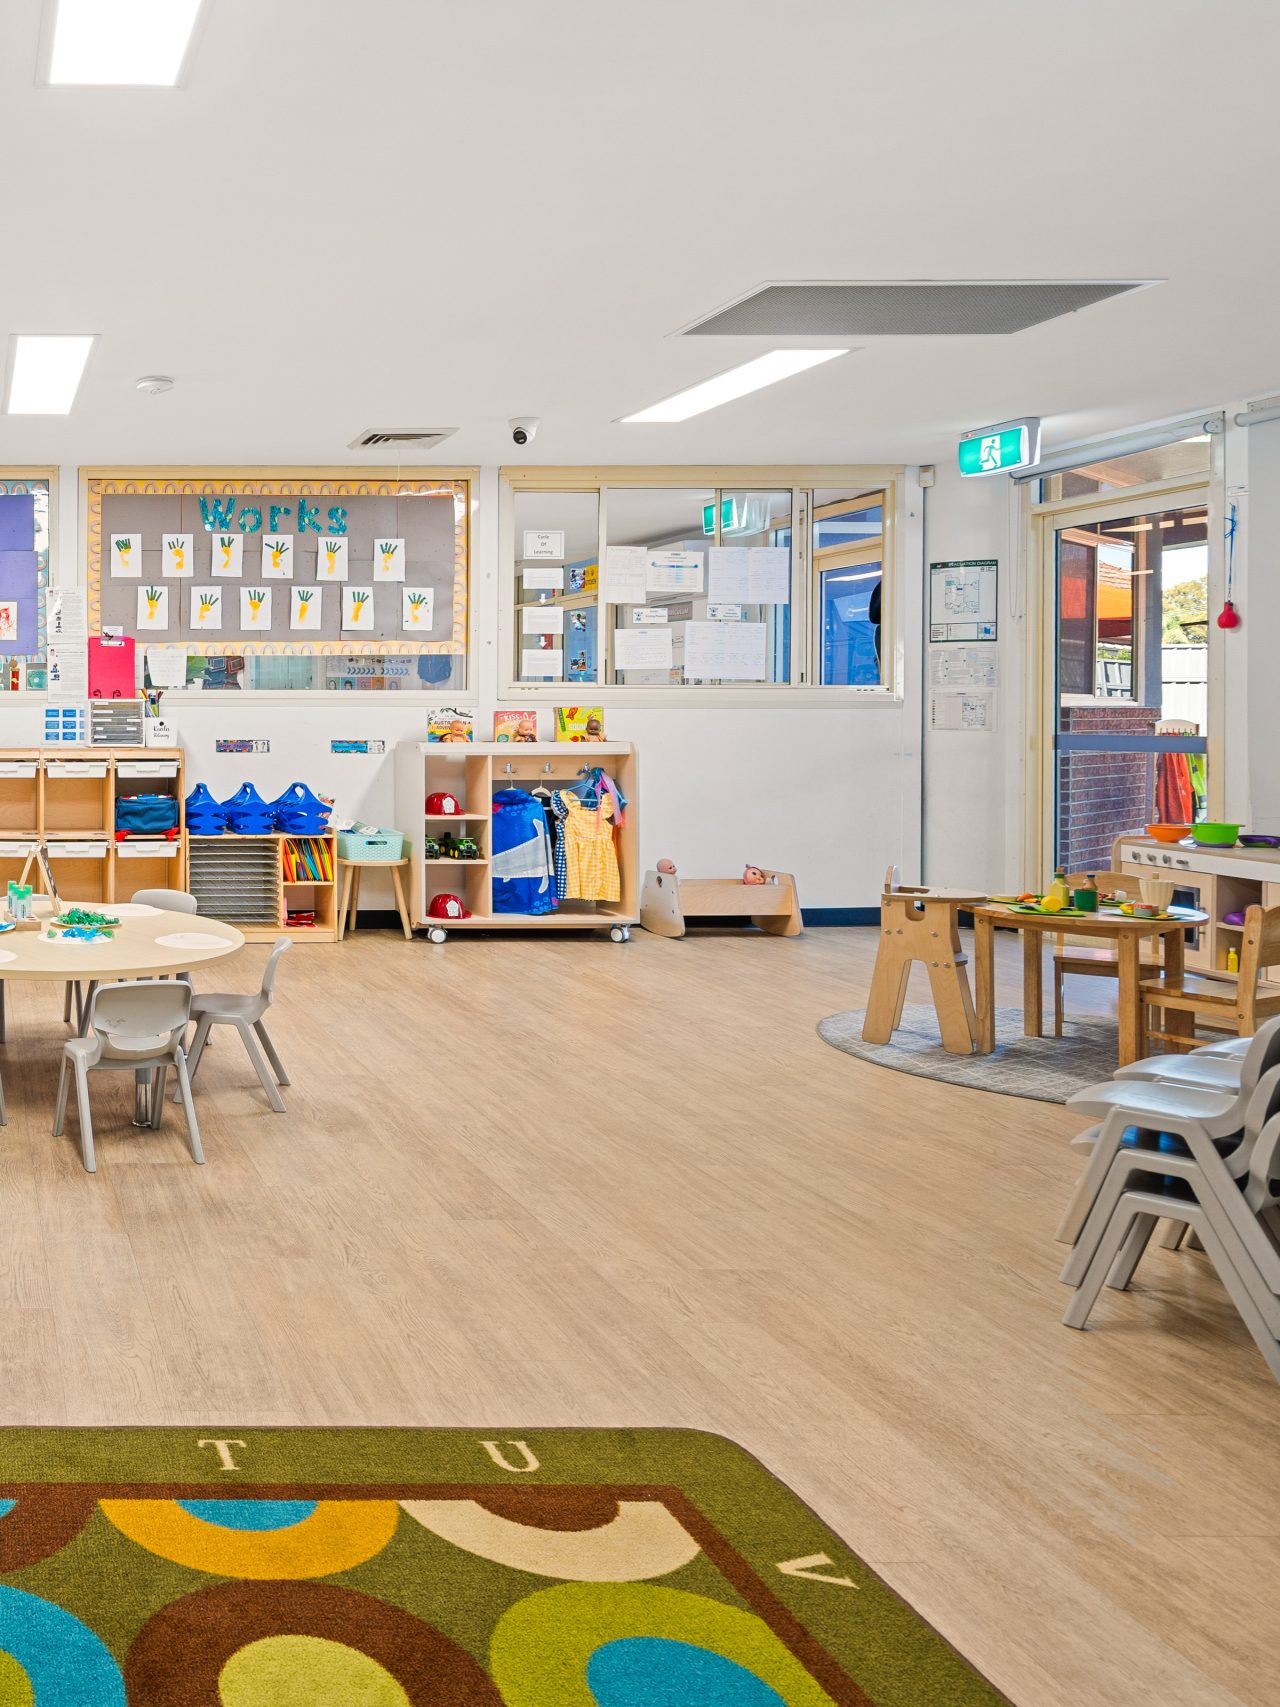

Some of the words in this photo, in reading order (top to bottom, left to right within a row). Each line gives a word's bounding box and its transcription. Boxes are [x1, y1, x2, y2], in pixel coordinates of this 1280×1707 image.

[199, 496, 348, 535] Works
[197, 1439, 247, 1471] T
[481, 1440, 540, 1472] U
[775, 1551, 860, 1589] V
